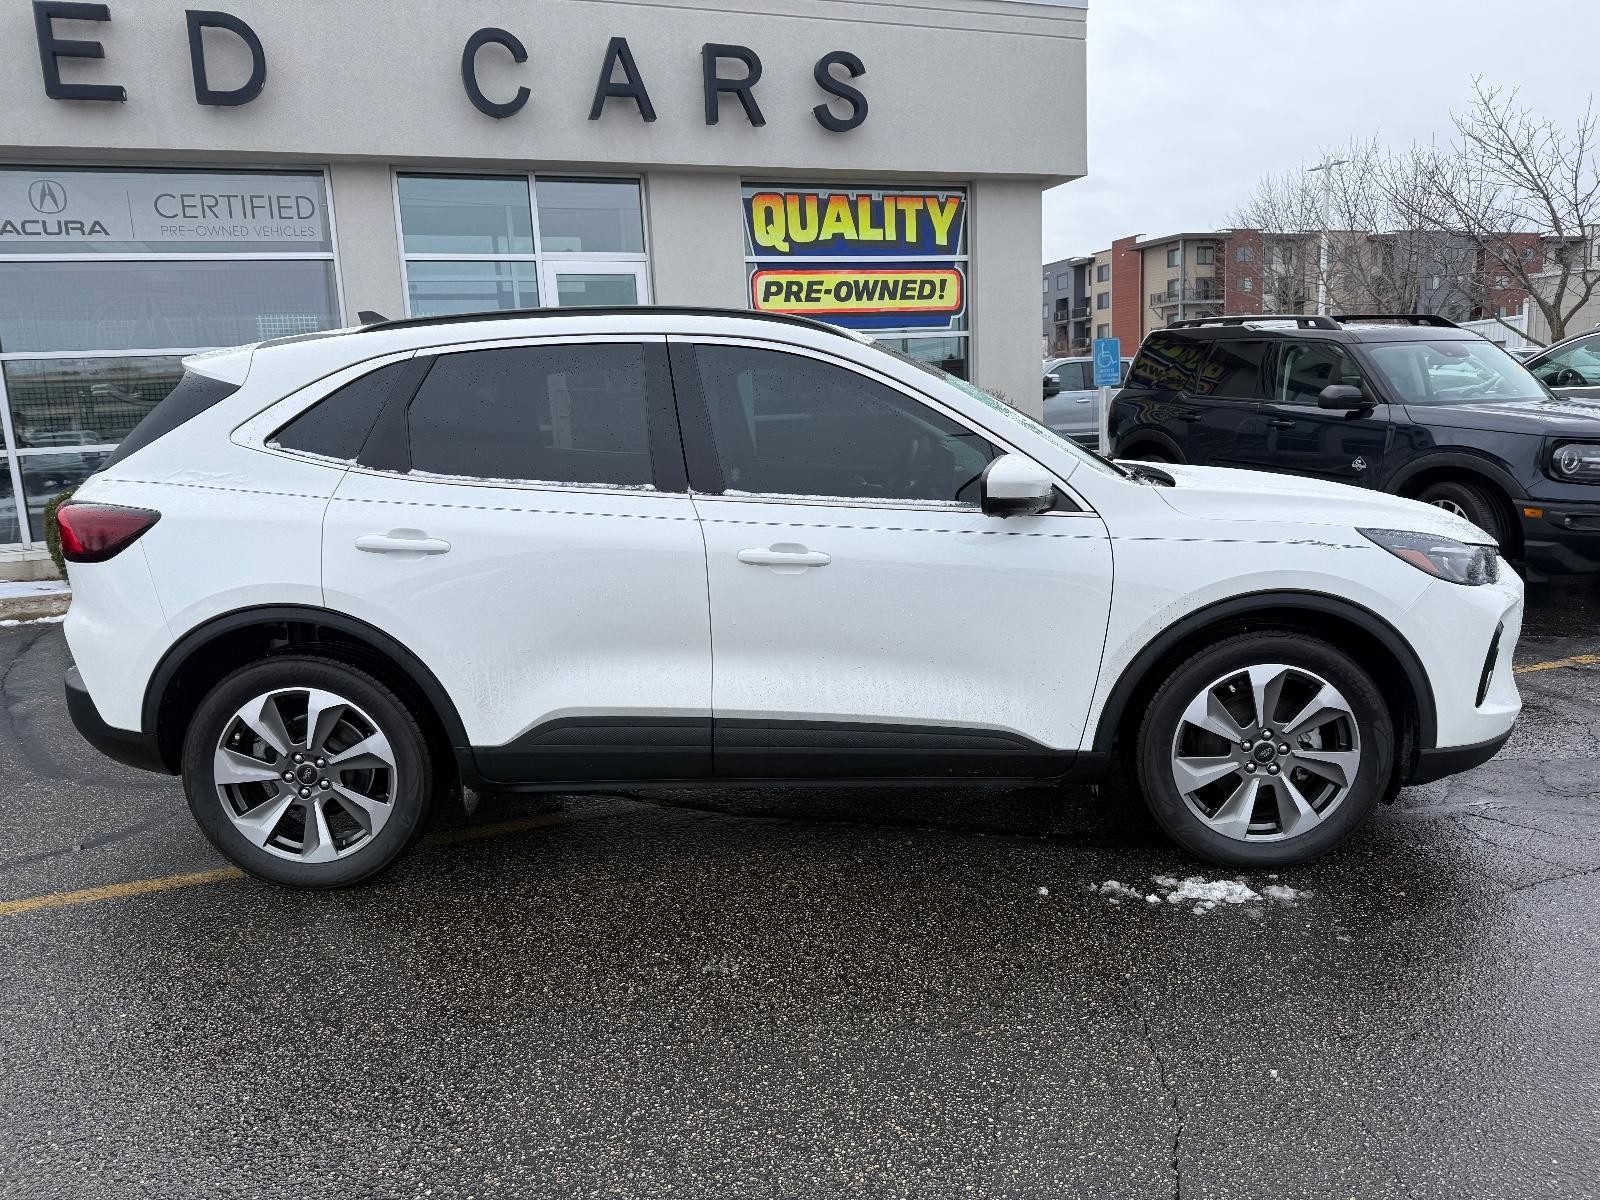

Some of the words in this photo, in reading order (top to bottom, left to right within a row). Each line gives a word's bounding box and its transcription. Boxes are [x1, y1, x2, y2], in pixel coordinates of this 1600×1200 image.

[461, 27, 868, 132] CARS
[154, 193, 315, 220] CERTIFIED
[0, 219, 111, 236] ACURA
[160, 225, 249, 237] PRE-OWNED
[253, 226, 315, 237] VEHICLES
[752, 194, 960, 252] QUALITY
[762, 278, 947, 302] PRE-OWNED!
